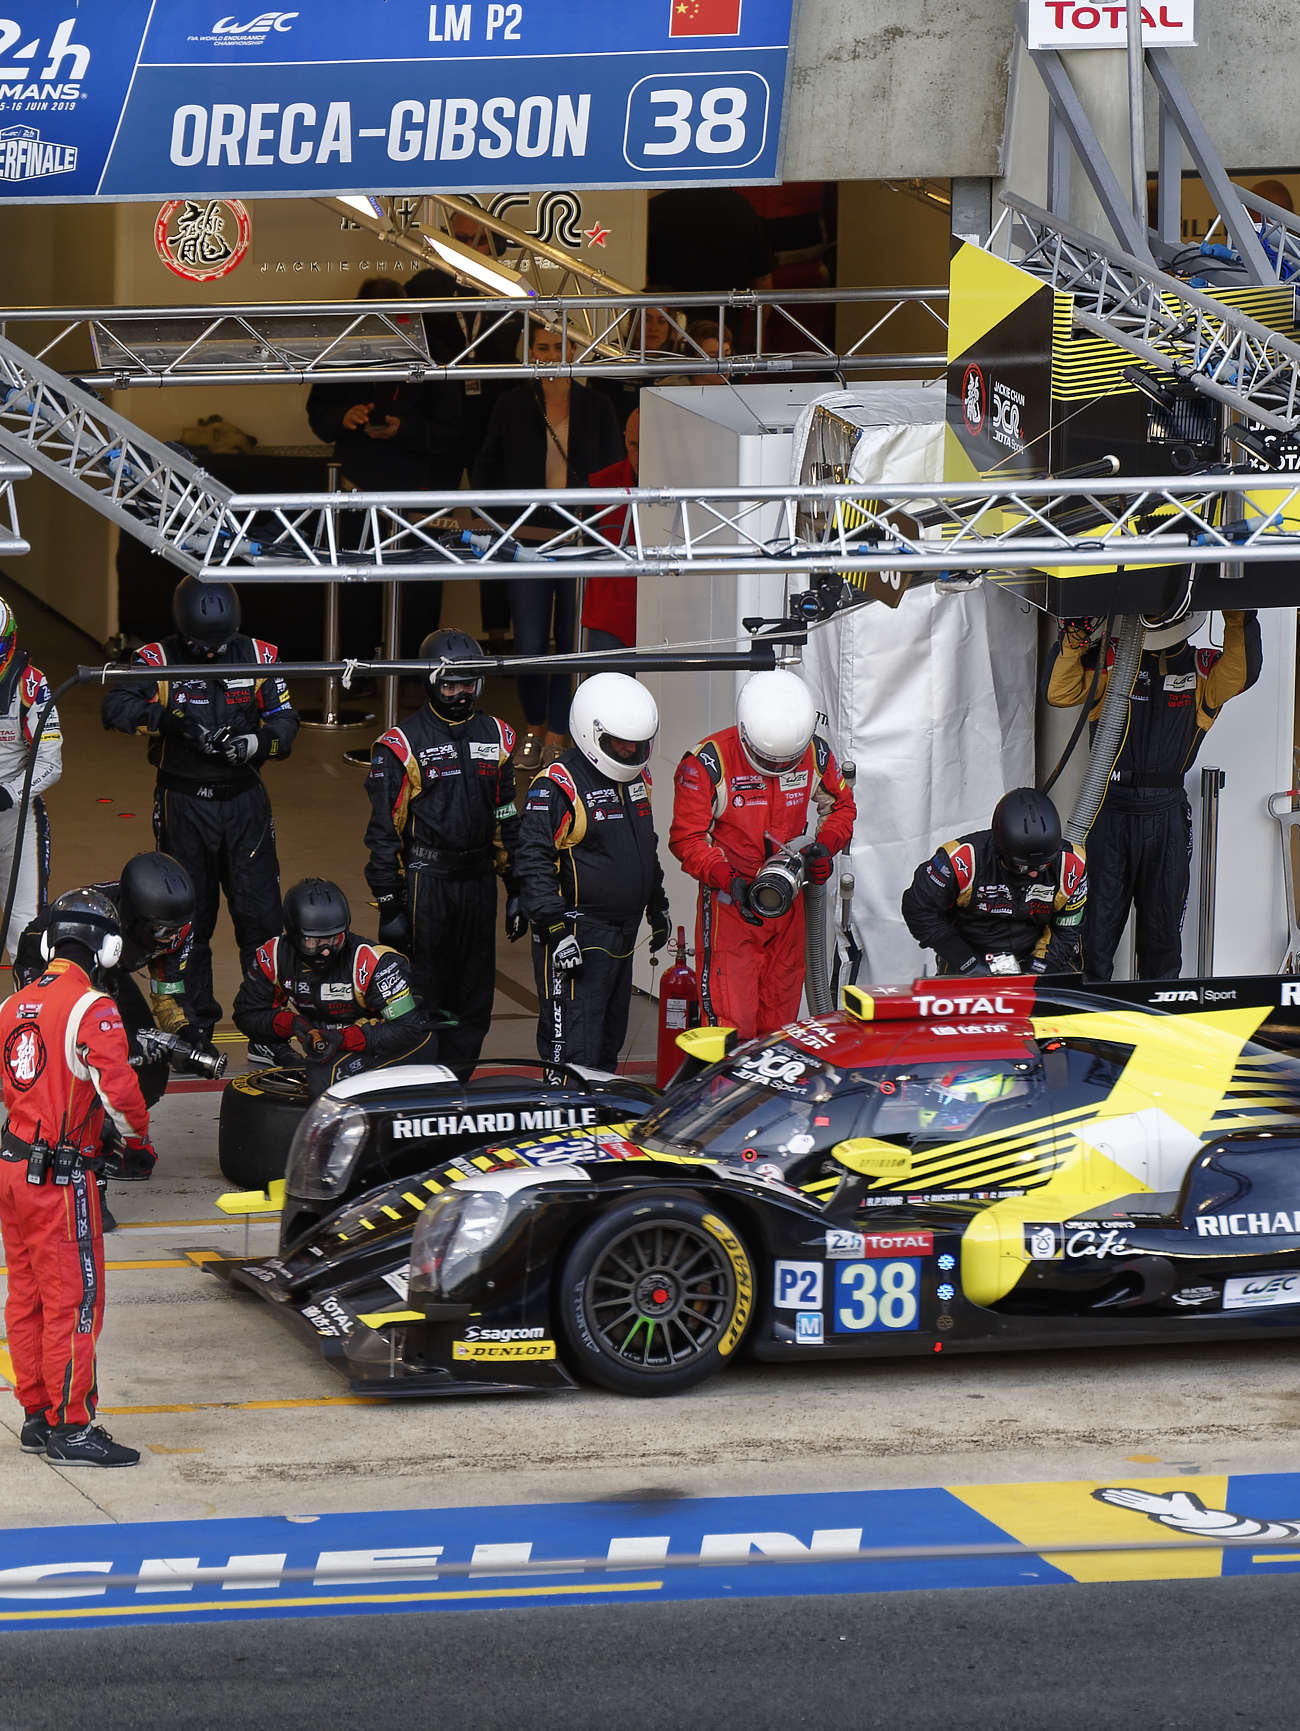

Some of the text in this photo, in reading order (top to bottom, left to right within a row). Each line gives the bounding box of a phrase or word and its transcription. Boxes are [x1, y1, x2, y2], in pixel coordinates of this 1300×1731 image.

[211, 11, 300, 34] WEC
[428, 3, 521, 42] LM P2
[1045, 1, 1183, 30] TOTAL
[0, 84, 80, 100] MANS
[25, 102, 48, 111] JUIN
[51, 102, 76, 111] 2019
[169, 94, 592, 167] ORECA-GIBSON
[643, 87, 748, 156] 38
[260, 260, 421, 274] JACKIE CHAN
[911, 995, 1015, 1017] TOTAL
[1148, 988, 1237, 1003] JOTA Sport
[553, 1001, 563, 1039] JOTA
[769, 1079, 808, 1096] Sport
[392, 1107, 597, 1141] RICHARD MILLE
[832, 1233, 865, 1250] 24h
[866, 1236, 930, 1250] TOTAL
[1066, 1229, 1140, 1259] Café
[720, 1236, 750, 1348] DUNLOP
[779, 1268, 817, 1303] P2
[839, 1261, 917, 1330] 38
[1242, 1276, 1298, 1296] WEC
[480, 1327, 545, 1343] sagcom
[801, 1317, 820, 1335] M
[471, 1346, 551, 1357] DUNLOP
